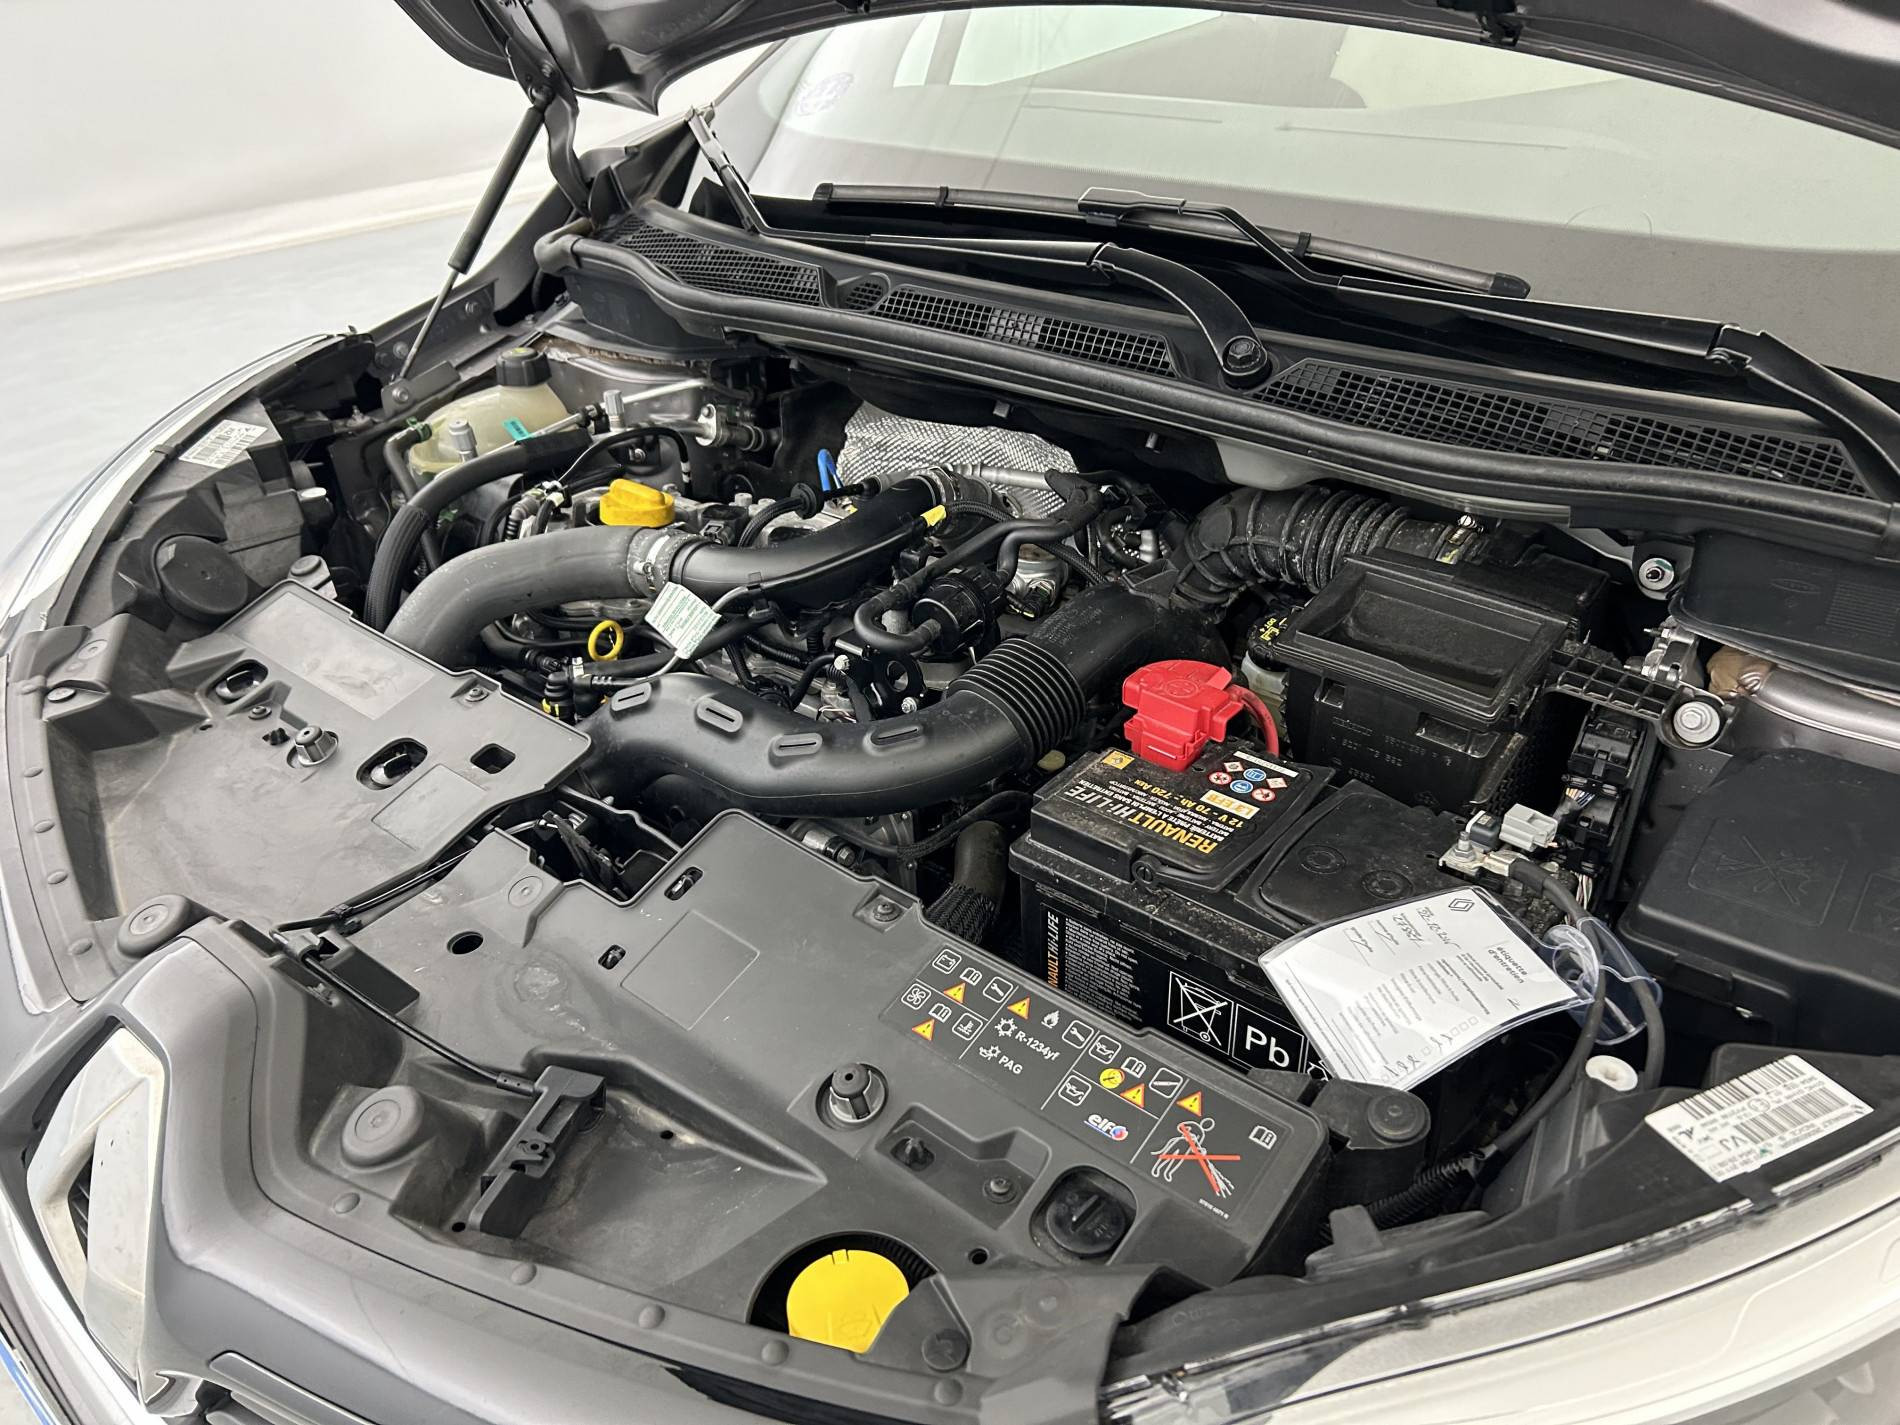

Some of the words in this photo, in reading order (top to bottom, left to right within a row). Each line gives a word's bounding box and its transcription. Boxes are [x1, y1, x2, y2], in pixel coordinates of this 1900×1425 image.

[1150, 786, 1172, 798] 720
[1178, 797, 1197, 808] Ah
[1194, 804, 1212, 814] 70
[1126, 811, 1218, 853] RENAULT
[1227, 817, 1245, 827] 12
[1047, 952, 1058, 988] NAULT
[1487, 948, 1525, 984] d'entretien
[1015, 1030, 1060, 1061] R-1234yf
[1245, 1024, 1290, 1068] Pb
[998, 1054, 1023, 1075] PAG
[1086, 1111, 1119, 1135] elf
